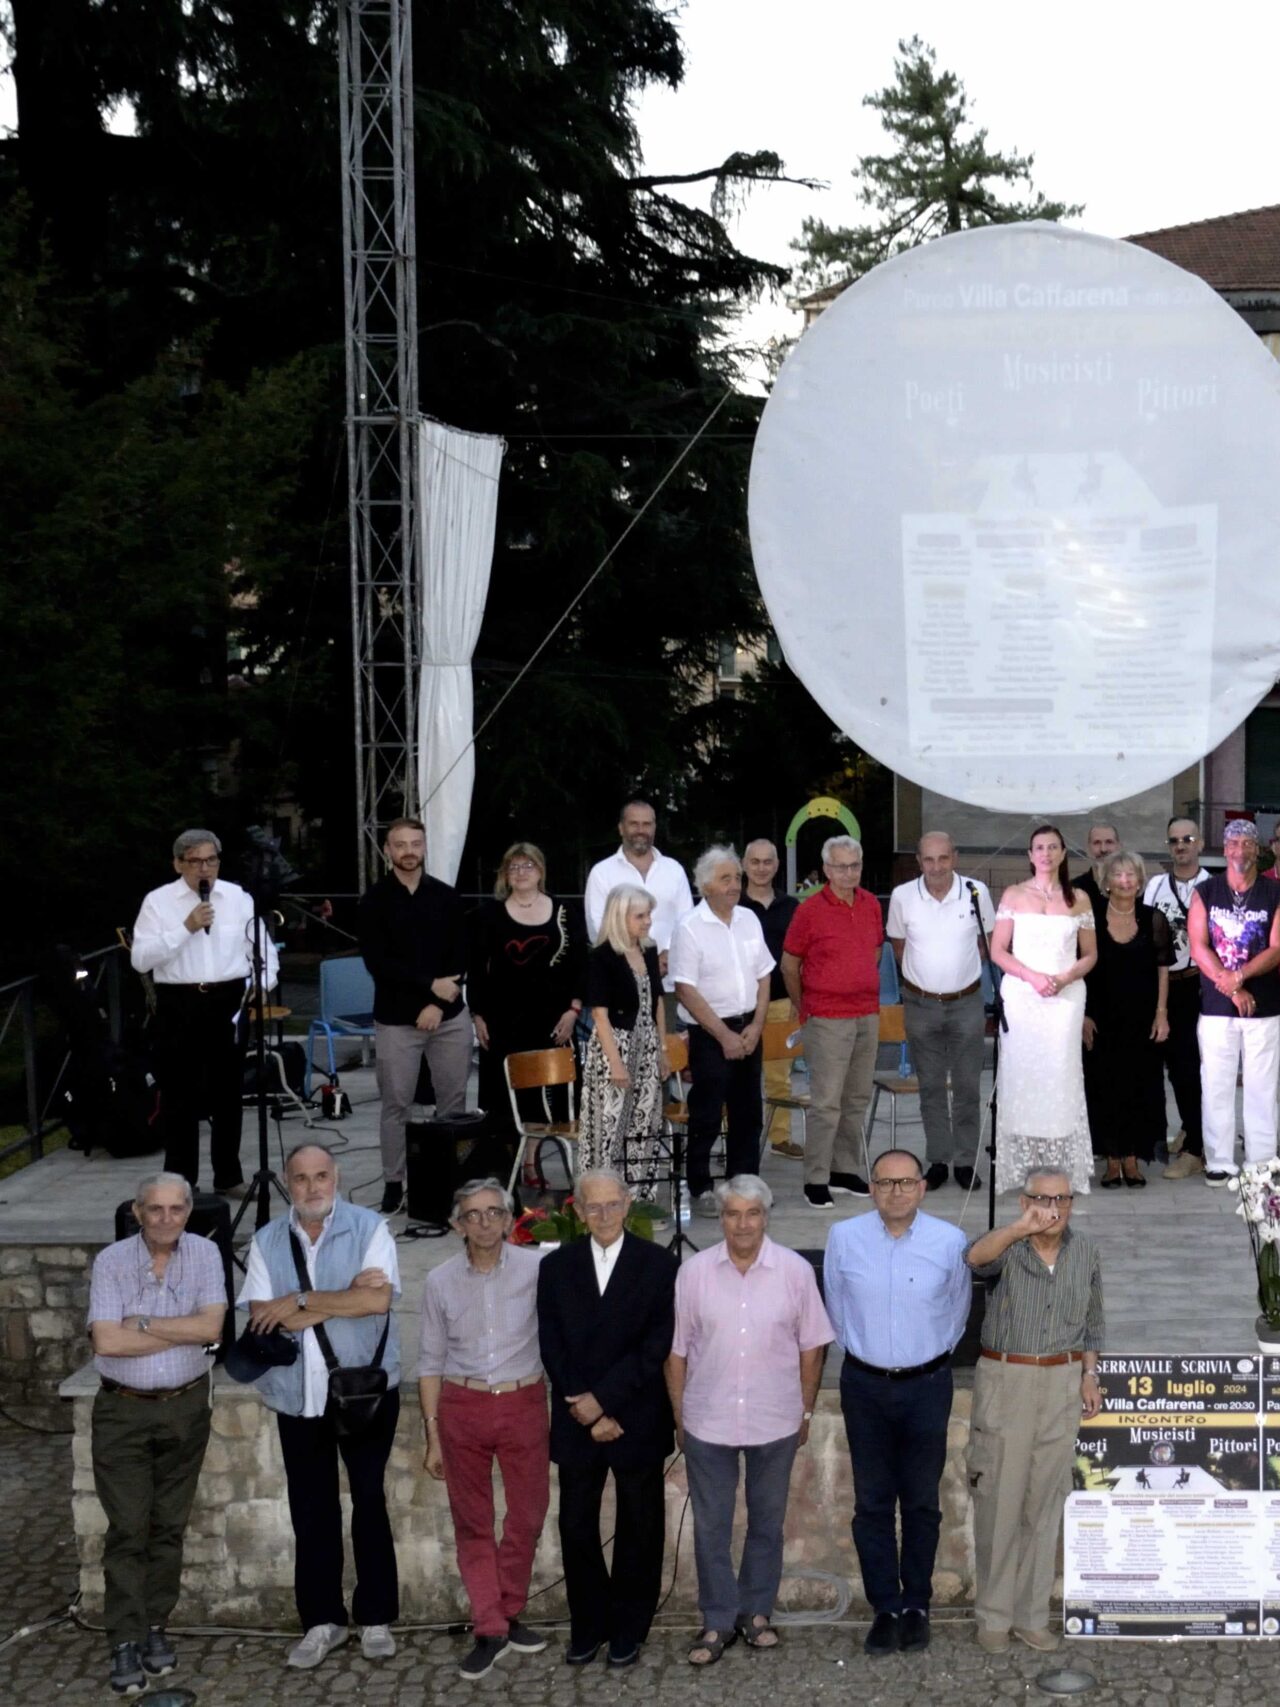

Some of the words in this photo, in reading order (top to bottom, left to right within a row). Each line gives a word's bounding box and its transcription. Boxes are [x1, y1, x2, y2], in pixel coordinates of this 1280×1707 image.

[958, 283, 1007, 308] Villa
[1013, 283, 1129, 308] Caffarena
[1002, 351, 1114, 392] Musicisti
[904, 379, 965, 420] Poeti
[1137, 375, 1218, 416] Pittori
[1095, 1359, 1173, 1374] SERRAVALLE
[1181, 1359, 1232, 1374] SCRIVIA
[1127, 1376, 1153, 1396] 13
[1167, 1380, 1216, 1398] luglio
[1223, 1385, 1247, 1394] 2024
[1104, 1398, 1134, 1410] Villa
[1137, 1398, 1205, 1410] Caffarena
[1213, 1402, 1229, 1410] ore
[1229, 1401, 1256, 1410] 20:30
[1130, 1427, 1196, 1444] Musicisti
[1209, 1437, 1258, 1454] Pittori
